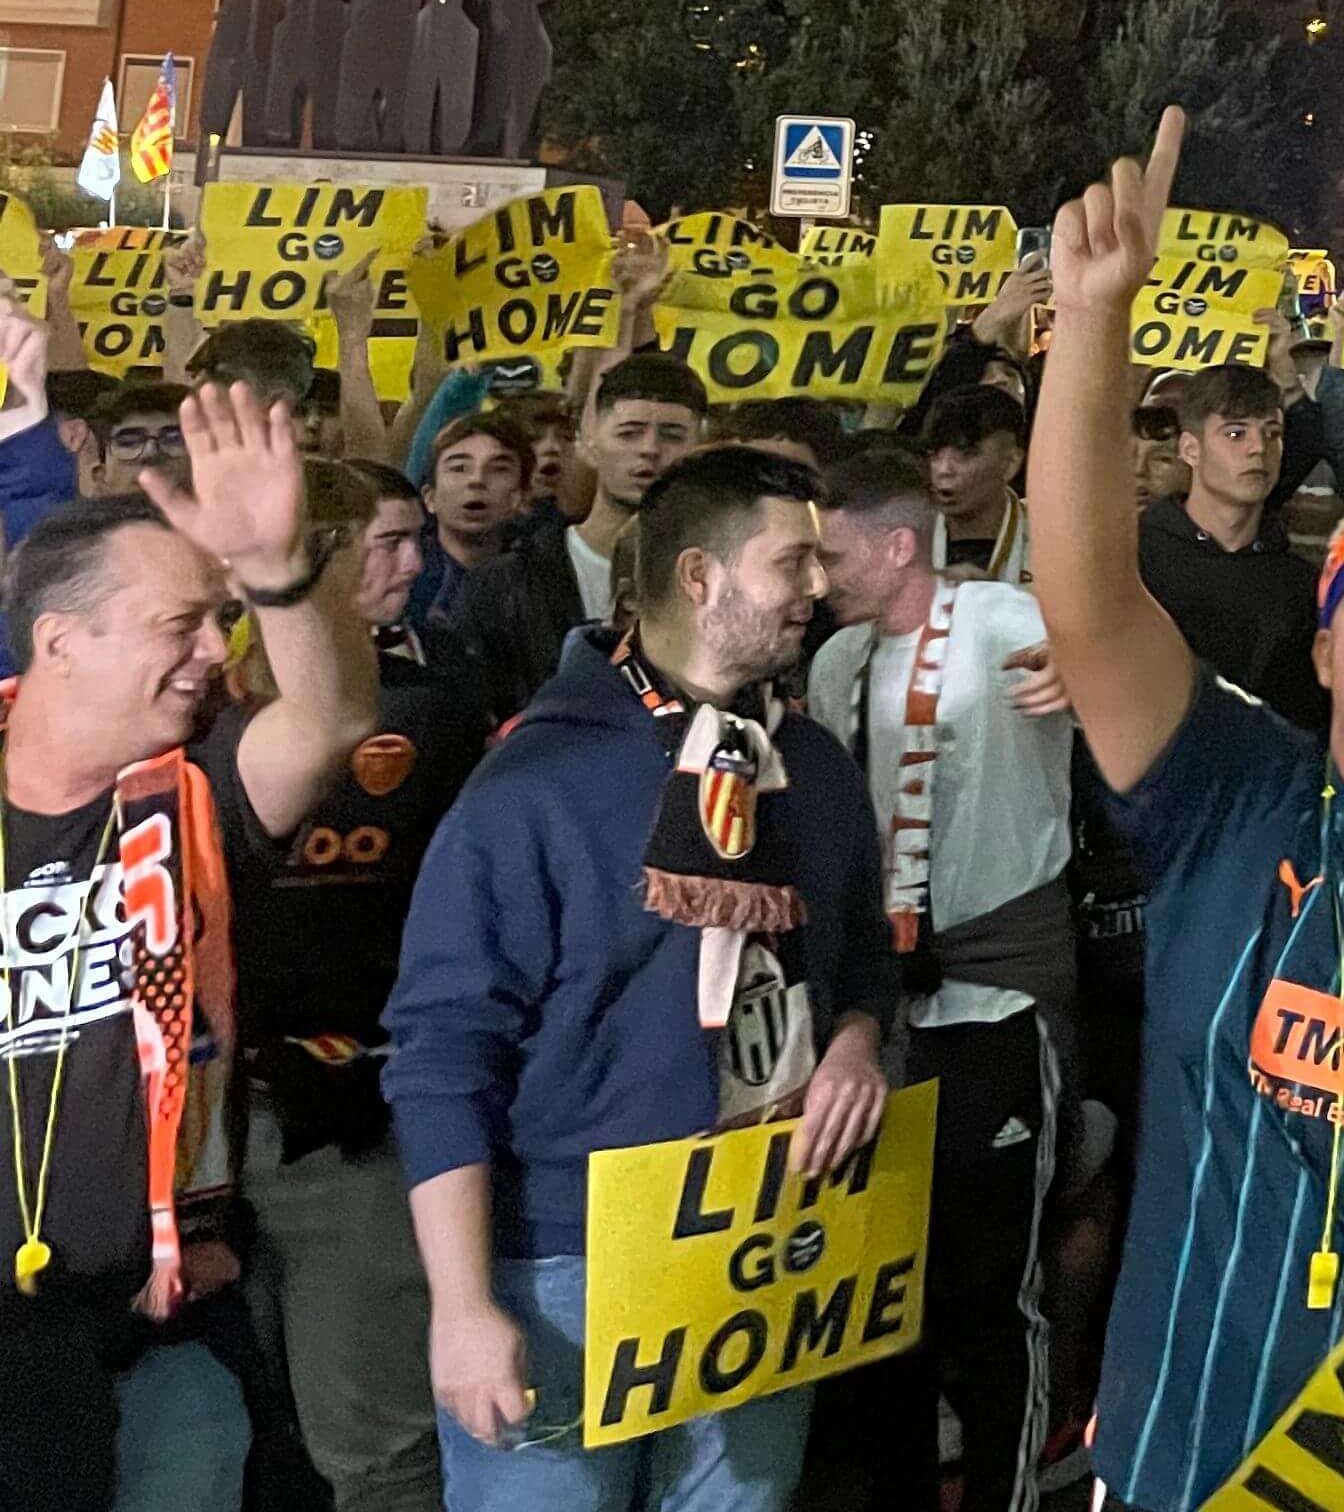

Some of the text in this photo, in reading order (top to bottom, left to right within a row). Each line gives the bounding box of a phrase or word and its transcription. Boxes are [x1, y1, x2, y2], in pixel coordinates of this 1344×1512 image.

[243, 187, 385, 228] LIM
[910, 207, 1003, 241] LIM
[454, 192, 576, 279] LIM
[812, 229, 877, 257] LIM
[1176, 213, 1261, 242] LIM
[277, 232, 345, 263] GO
[931, 244, 976, 265] GO
[1196, 244, 1238, 263] GO
[203, 269, 408, 311] HOE
[494, 253, 560, 289] GO
[729, 277, 840, 321] GO
[1154, 292, 1208, 317] GO
[445, 288, 613, 363] HOME
[1133, 321, 1261, 364] OME
[1276, 1088, 1323, 1118] Real
[672, 1131, 878, 1240] LIM
[729, 1220, 825, 1292] GO
[600, 1252, 917, 1427] HOME
